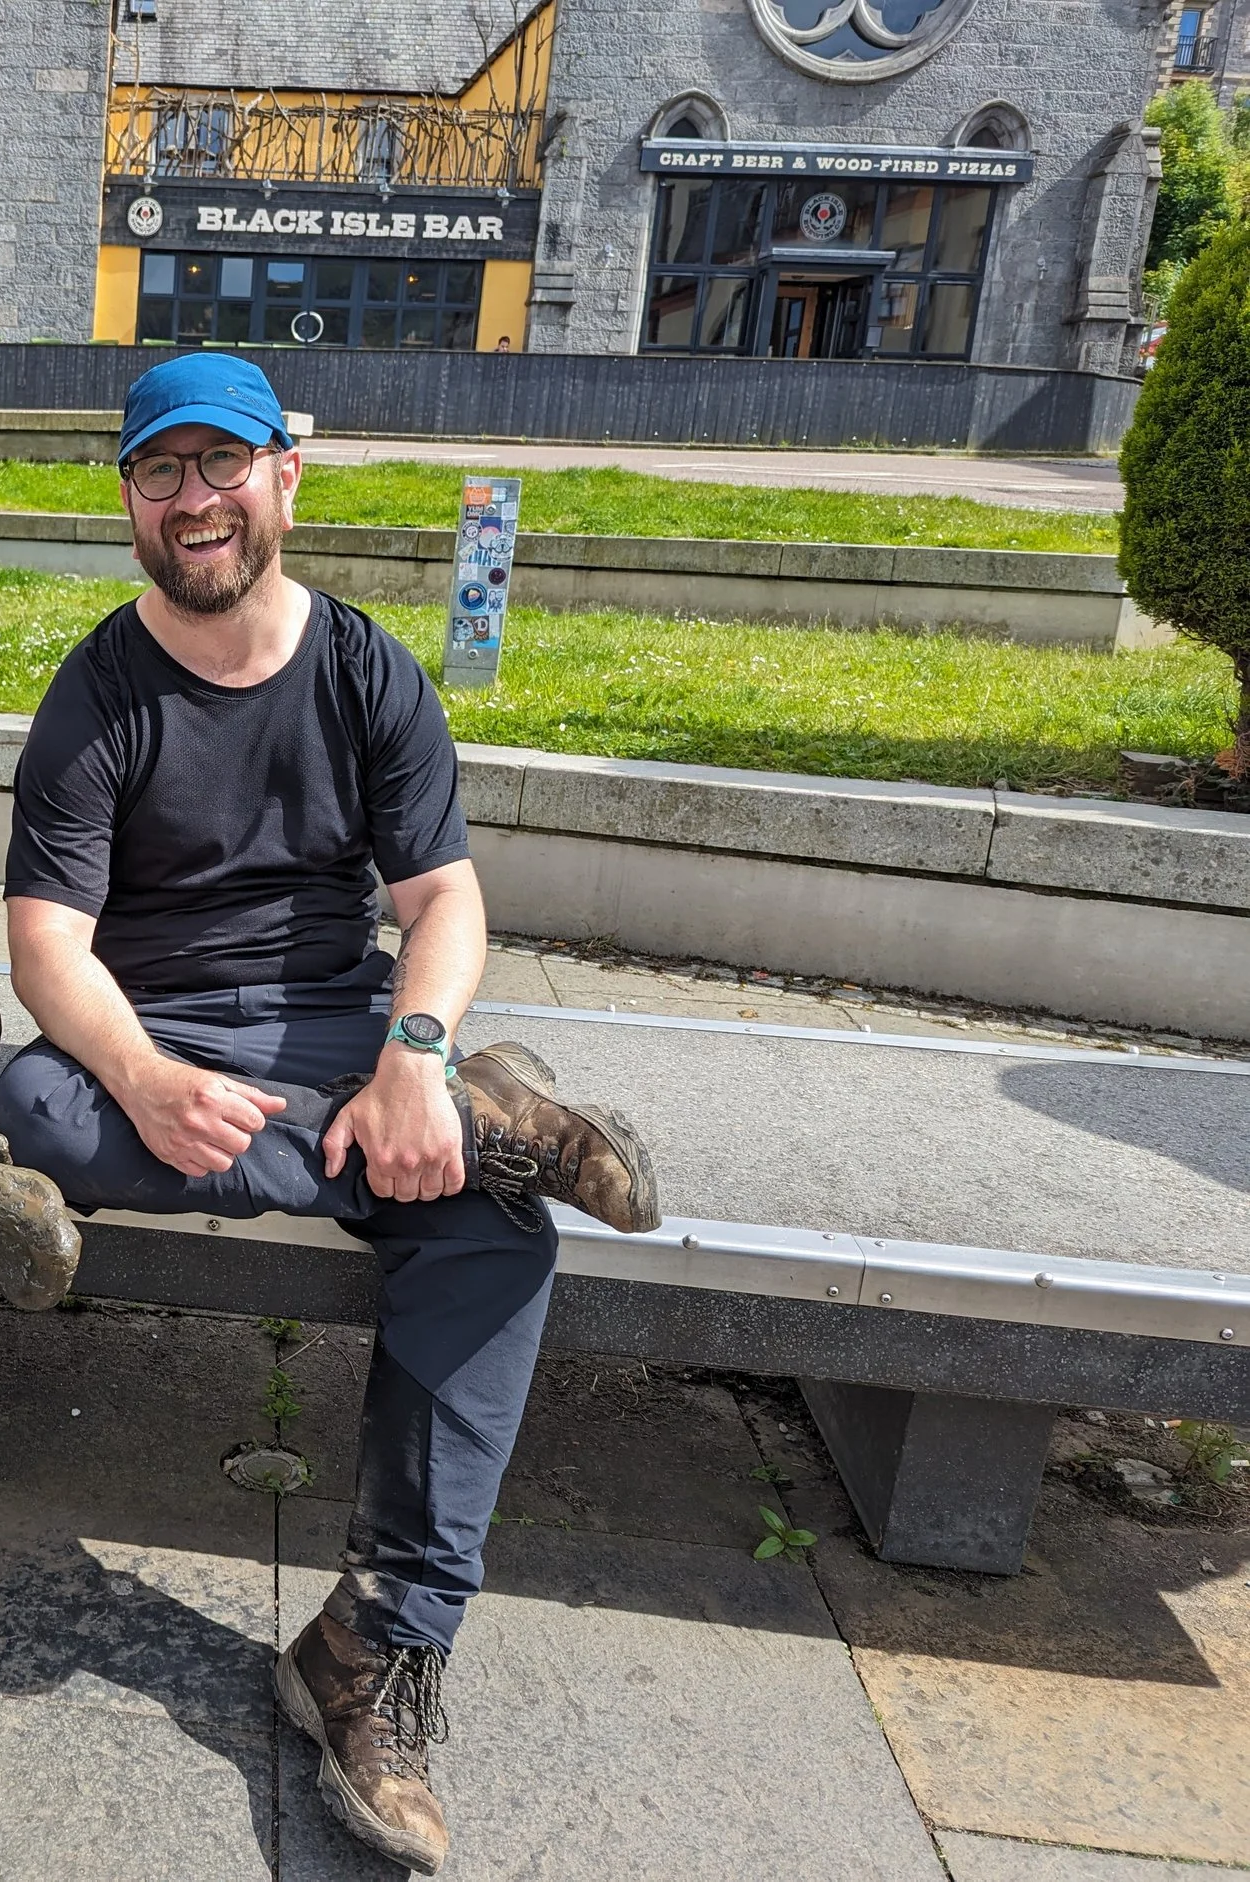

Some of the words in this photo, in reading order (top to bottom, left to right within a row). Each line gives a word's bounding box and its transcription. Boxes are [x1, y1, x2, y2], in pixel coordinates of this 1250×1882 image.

[659, 152, 724, 168] CRAFT
[732, 155, 783, 169] BEER
[792, 156, 806, 169] &
[817, 157, 939, 174] WOOD-FIRED
[947, 161, 1017, 177] PIZZAS
[197, 206, 324, 235] BLACK
[330, 211, 416, 238] ISLE
[423, 214, 504, 241] BAR
